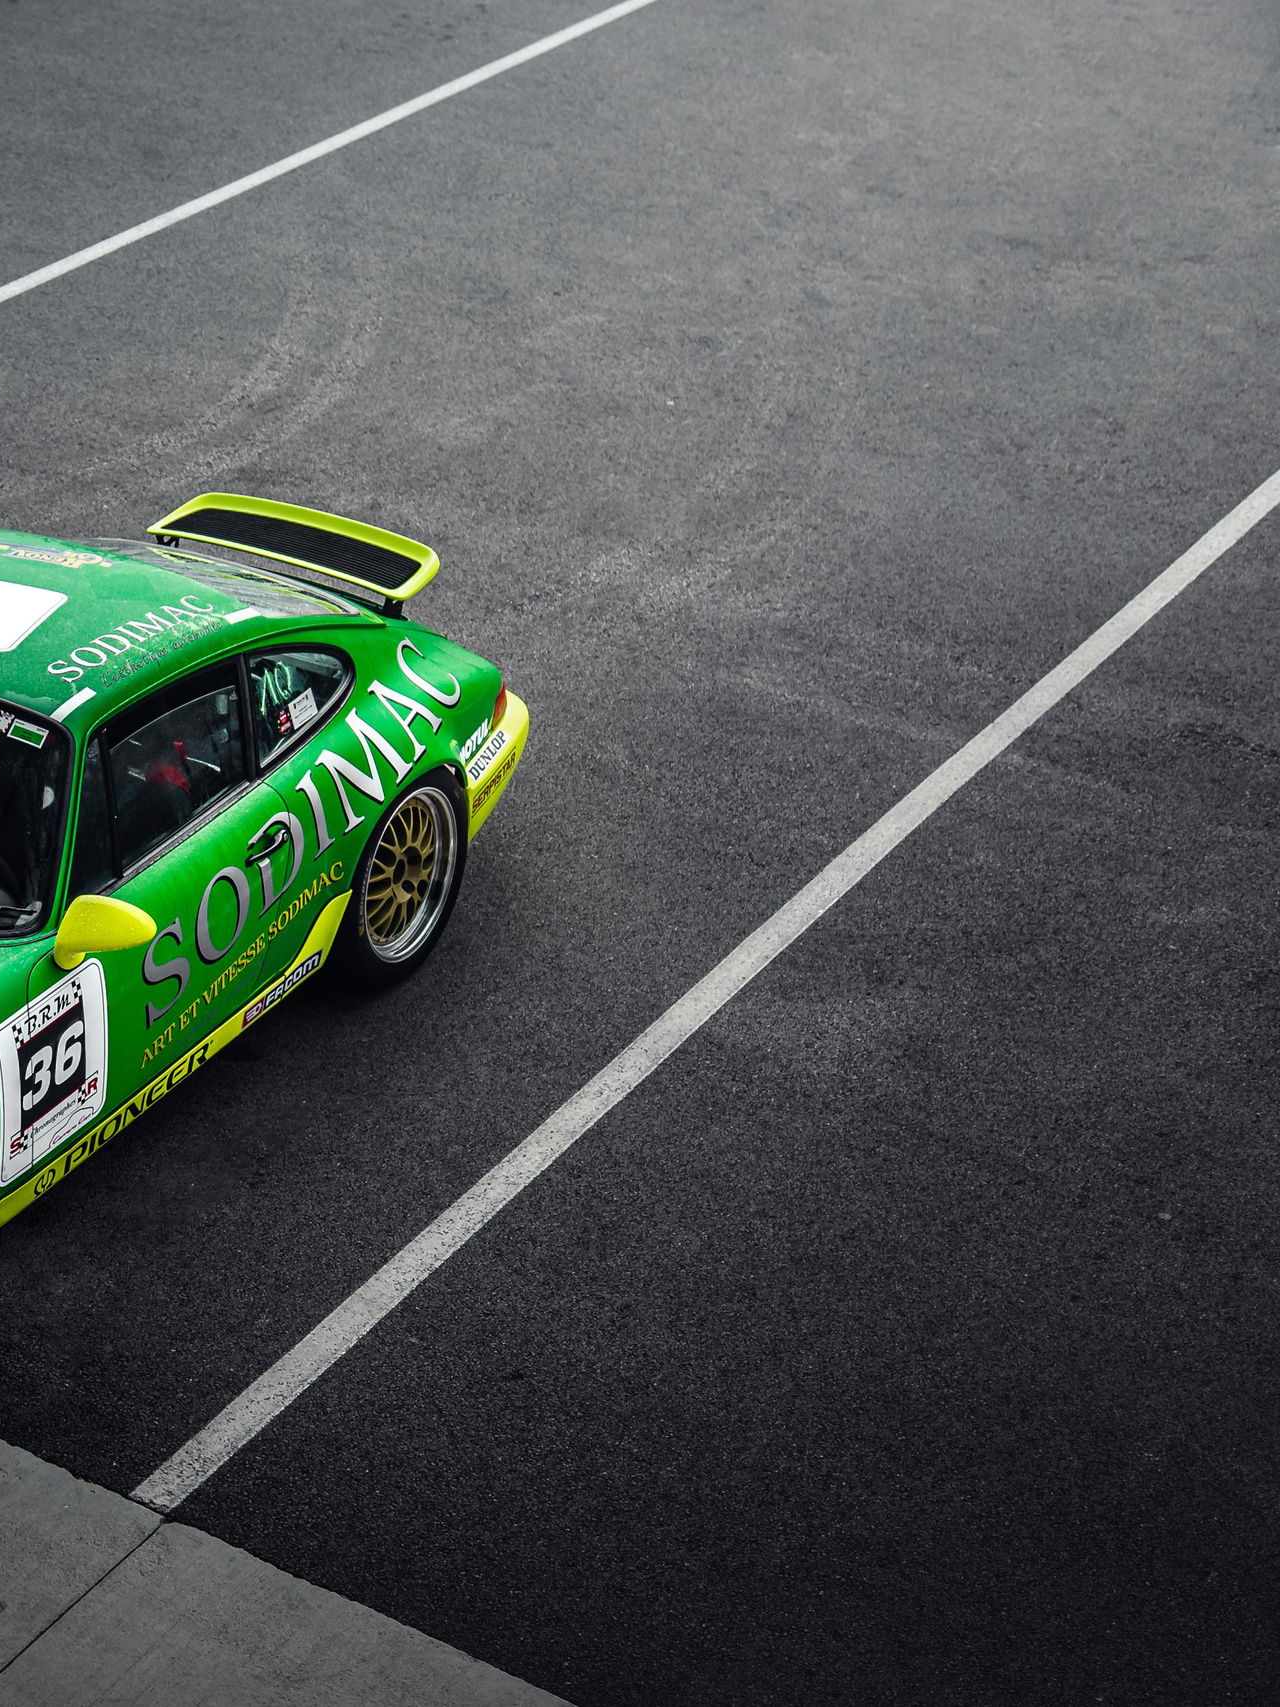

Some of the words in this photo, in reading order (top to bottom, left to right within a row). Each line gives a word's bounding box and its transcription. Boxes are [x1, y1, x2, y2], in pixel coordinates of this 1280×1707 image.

[47, 595, 213, 683] SODIMAC
[469, 731, 506, 780] DUNLOP
[472, 752, 516, 814] SERPISTAR
[142, 636, 461, 1029] SODIMAC
[140, 1024, 175, 1070] ART
[179, 999, 200, 1031] ET
[203, 933, 266, 1005] VITESSE
[268, 861, 345, 943] SODIMAC
[265, 954, 320, 1006] FACOM
[24, 992, 71, 1036] B.R.M
[22, 1020, 84, 1111] 36
[64, 1042, 210, 1176] PIONEER
